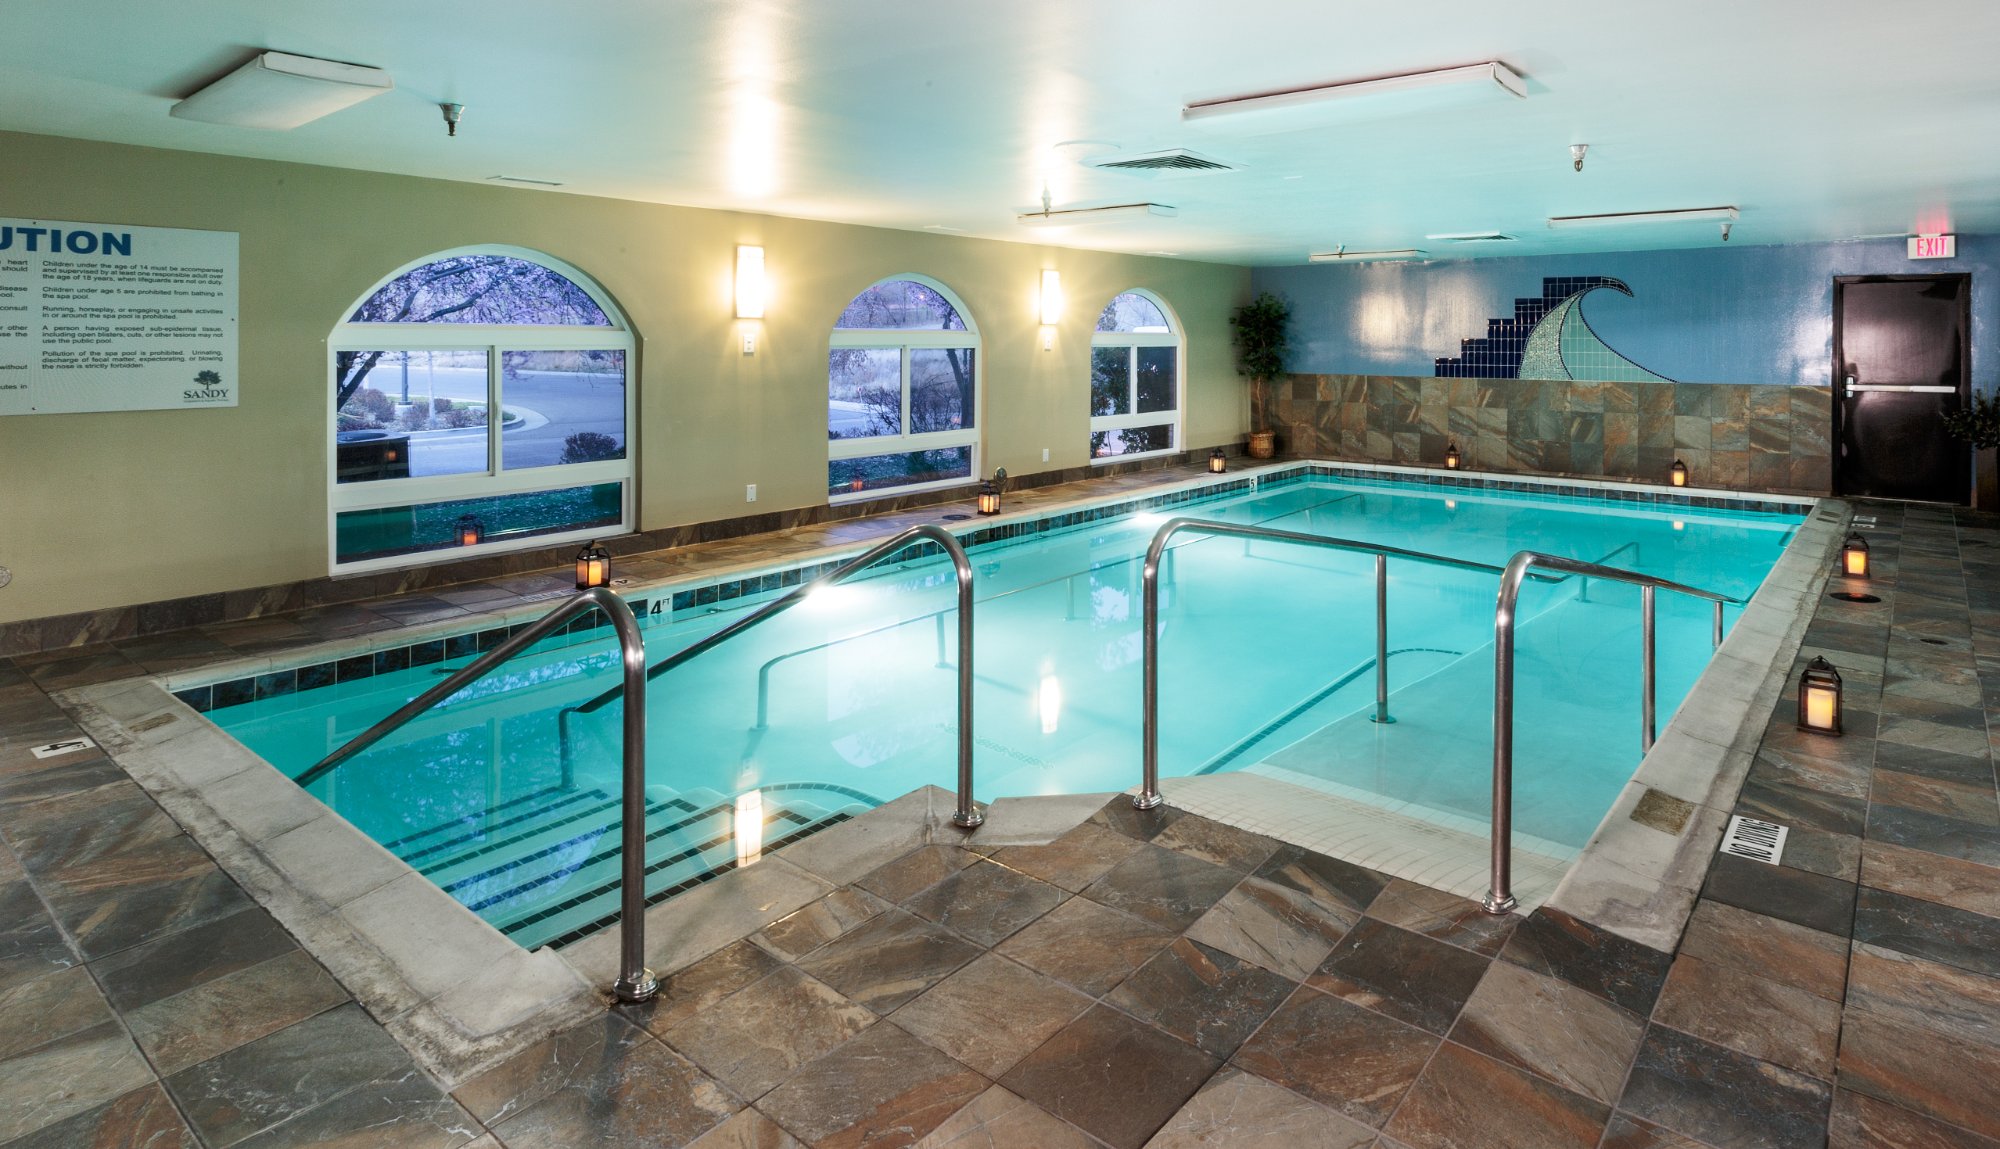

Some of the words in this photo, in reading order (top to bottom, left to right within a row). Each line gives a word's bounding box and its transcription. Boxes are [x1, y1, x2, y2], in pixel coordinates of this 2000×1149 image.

[1917, 238, 1948, 256] EXIT
[184, 389, 229, 398] SANDY
[650, 600, 662, 614] 4
[1732, 817, 1779, 848] DIVING
[1728, 842, 1772, 861] NO
